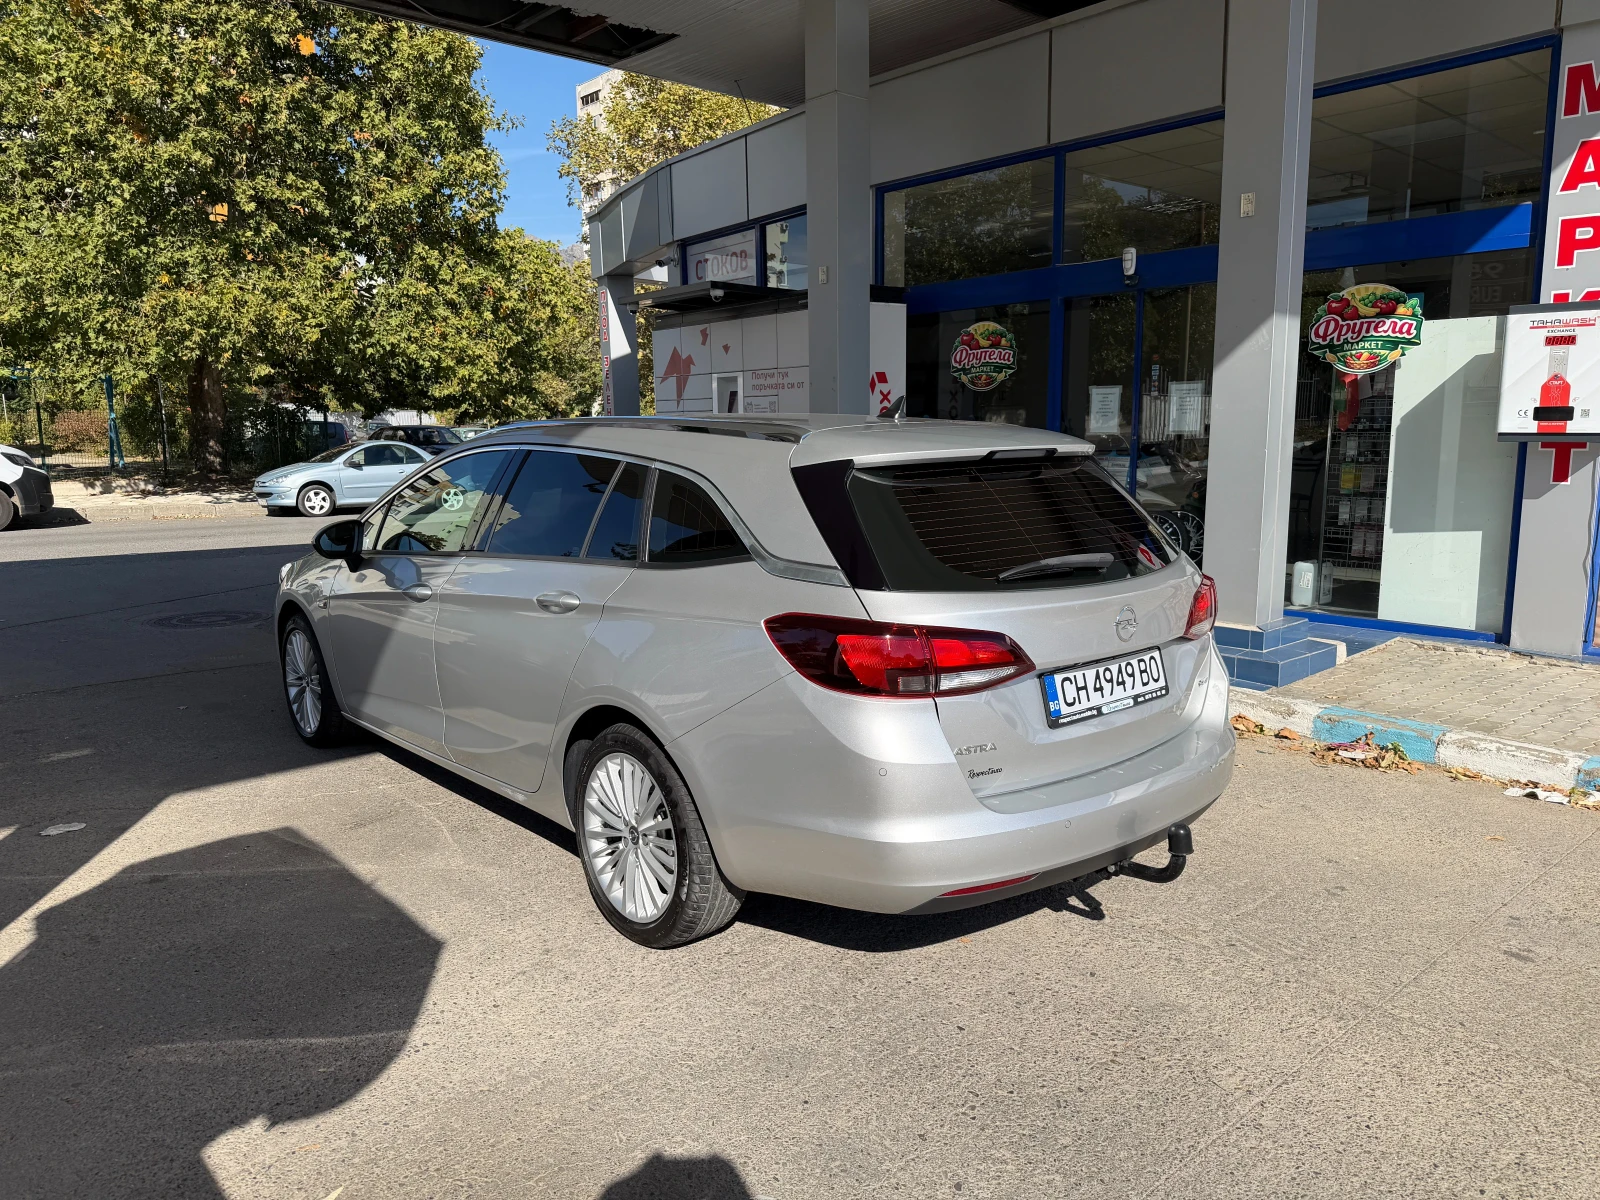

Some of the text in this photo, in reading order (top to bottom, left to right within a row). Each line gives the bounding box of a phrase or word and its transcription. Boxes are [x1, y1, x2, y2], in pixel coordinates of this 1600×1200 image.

[695, 249, 749, 281] СТОКОВ
[1312, 316, 1416, 343] Фрутела
[1343, 341, 1384, 351] МАРКЕТ
[953, 347, 1013, 367] Фрутела
[752, 371, 789, 381] Получи тук
[752, 382, 786, 392] поръчката
[787, 382, 795, 390] си
[1060, 655, 1161, 708] CH 4949 BO
[1049, 700, 1060, 712] BG
[953, 742, 997, 756] ASTRA
